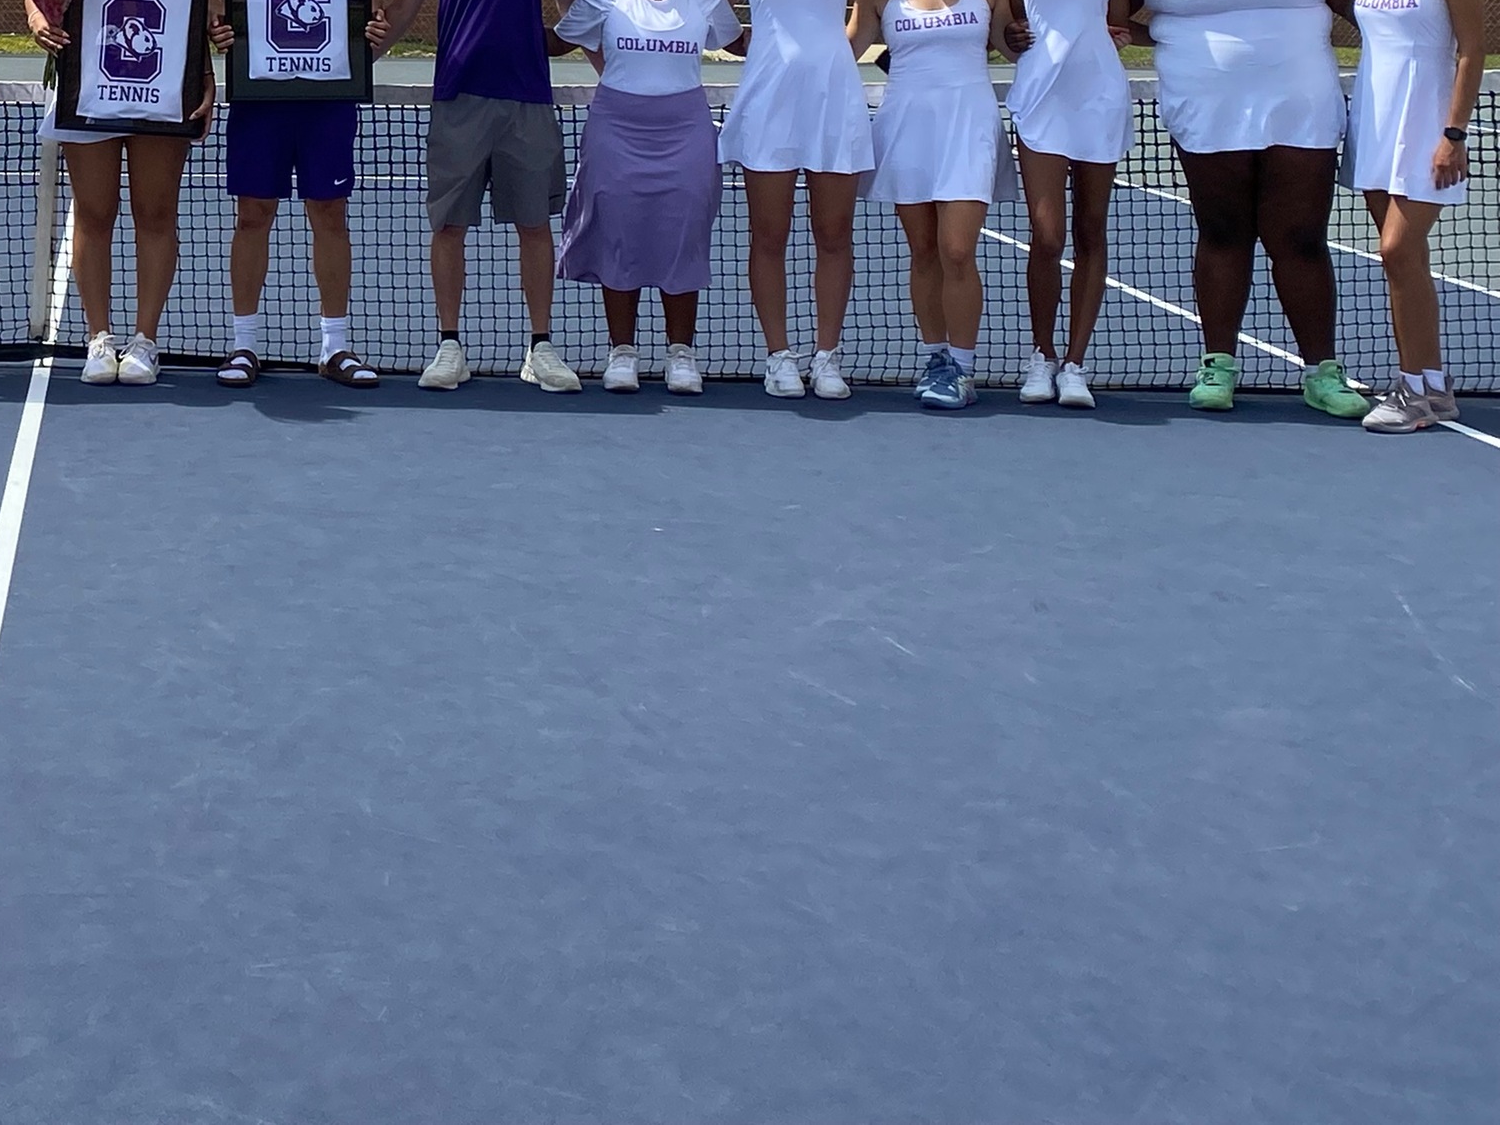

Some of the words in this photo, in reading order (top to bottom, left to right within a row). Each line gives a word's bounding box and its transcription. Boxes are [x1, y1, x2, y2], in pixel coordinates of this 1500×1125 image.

[895, 12, 979, 33] COLUMBIA
[616, 37, 699, 55] COLUMBIA
[266, 56, 331, 73] TENNIS
[98, 84, 160, 104] TENNIS
